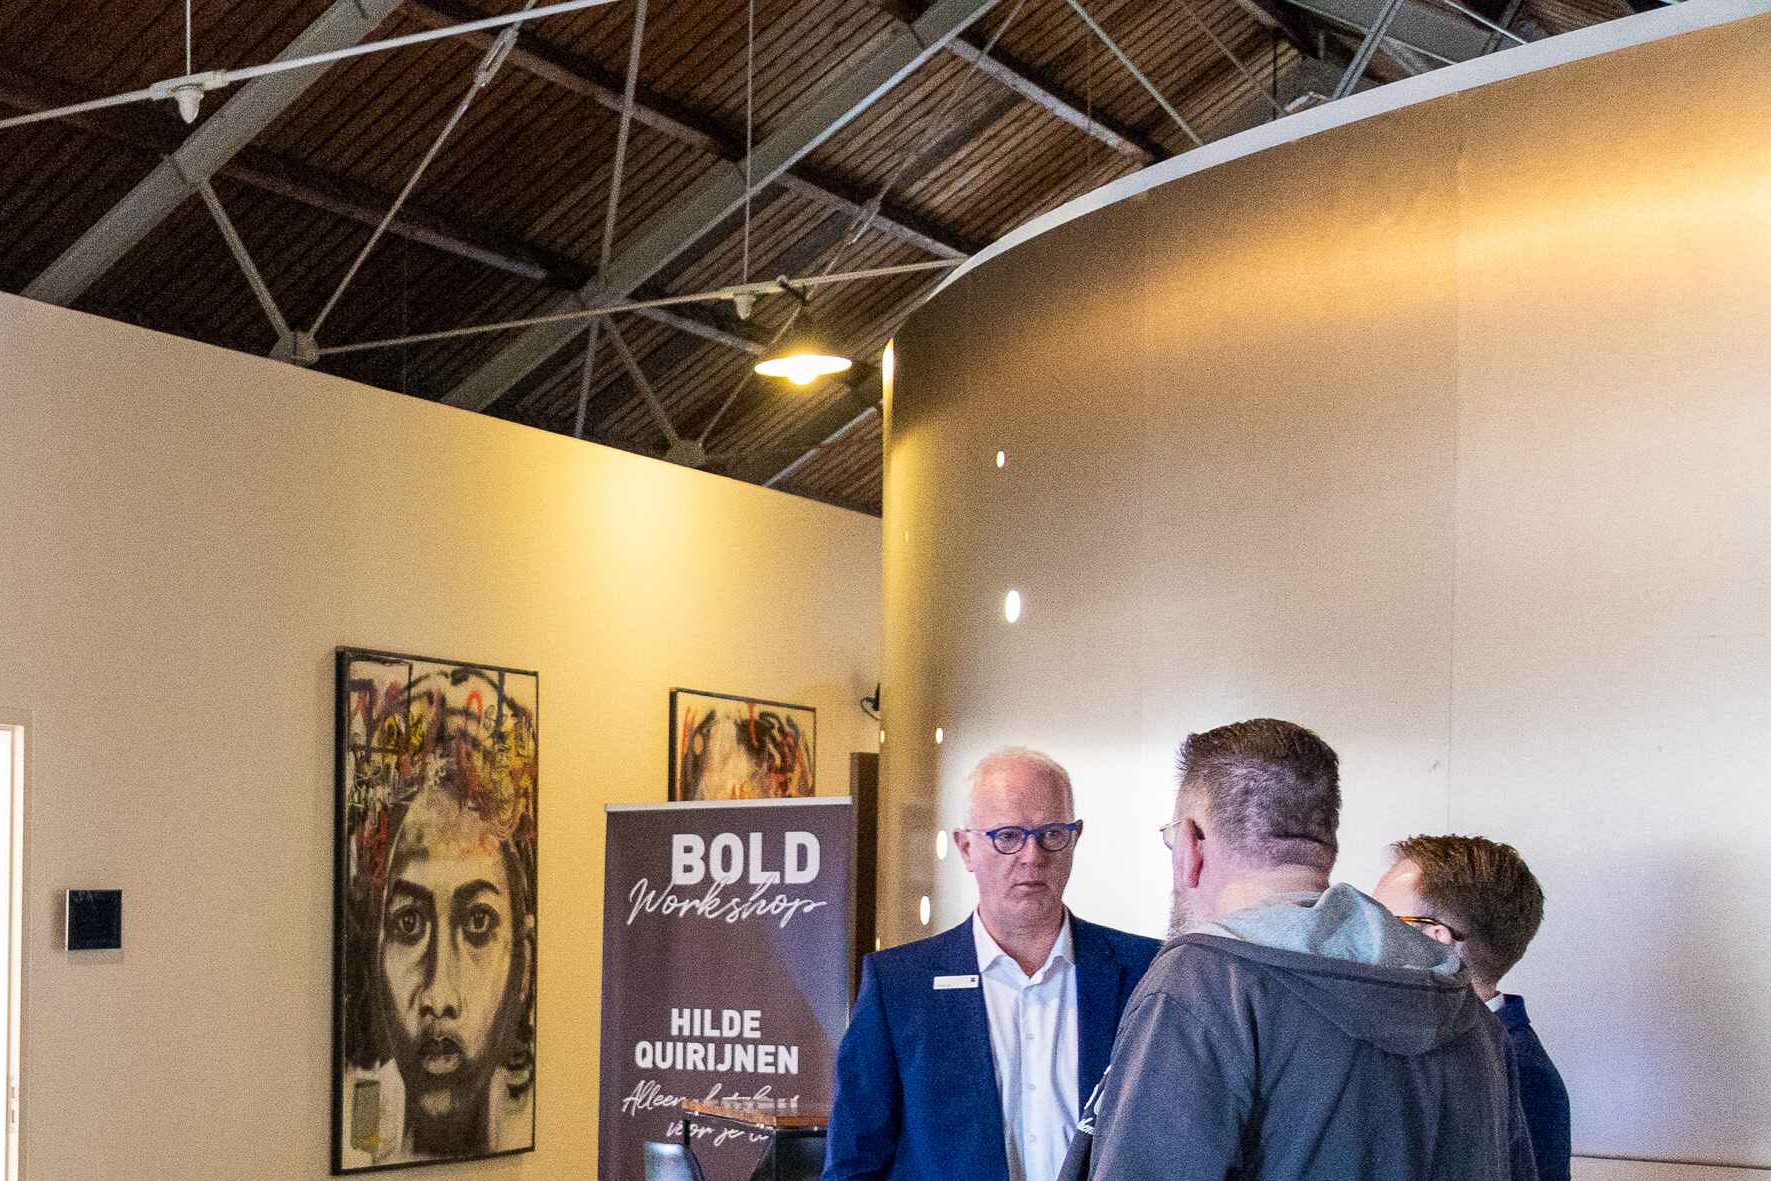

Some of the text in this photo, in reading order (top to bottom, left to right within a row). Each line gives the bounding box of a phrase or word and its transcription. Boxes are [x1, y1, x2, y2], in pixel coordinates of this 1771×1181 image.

[672, 831, 821, 885] BOLD
[627, 872, 828, 928] Workshop
[671, 1008, 762, 1038] HILDE
[635, 1041, 799, 1075] QUIRIJNEN
